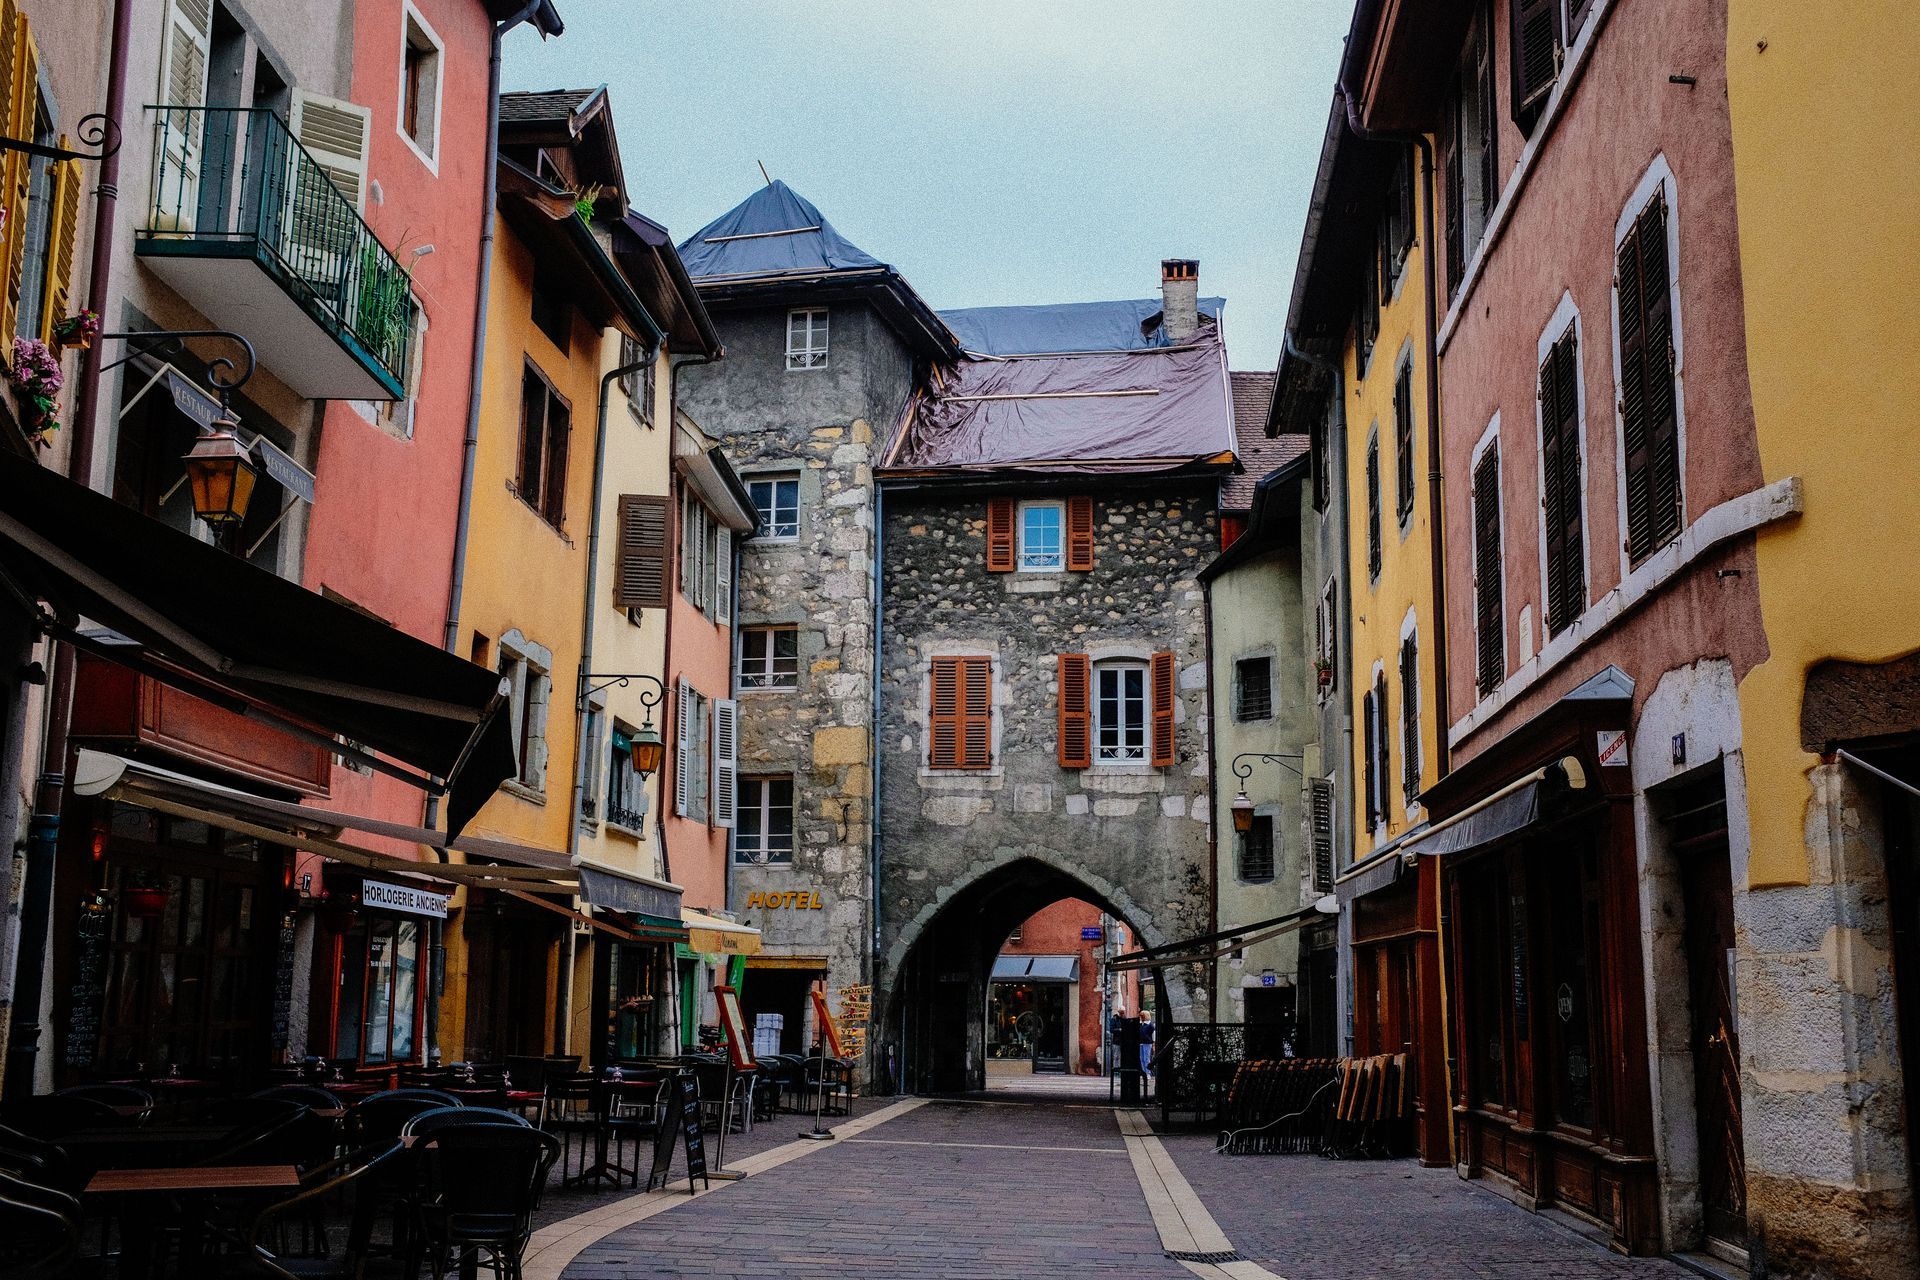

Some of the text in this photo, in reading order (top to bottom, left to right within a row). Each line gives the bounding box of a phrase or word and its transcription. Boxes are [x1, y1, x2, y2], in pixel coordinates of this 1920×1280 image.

[266, 454, 307, 492] RESTAURANT
[1599, 733, 1626, 762] LICENCE
[1673, 737, 1682, 758] 18
[364, 885, 446, 913] HORLOGERIE ANCIENNE
[747, 890, 823, 909] HOTEL
